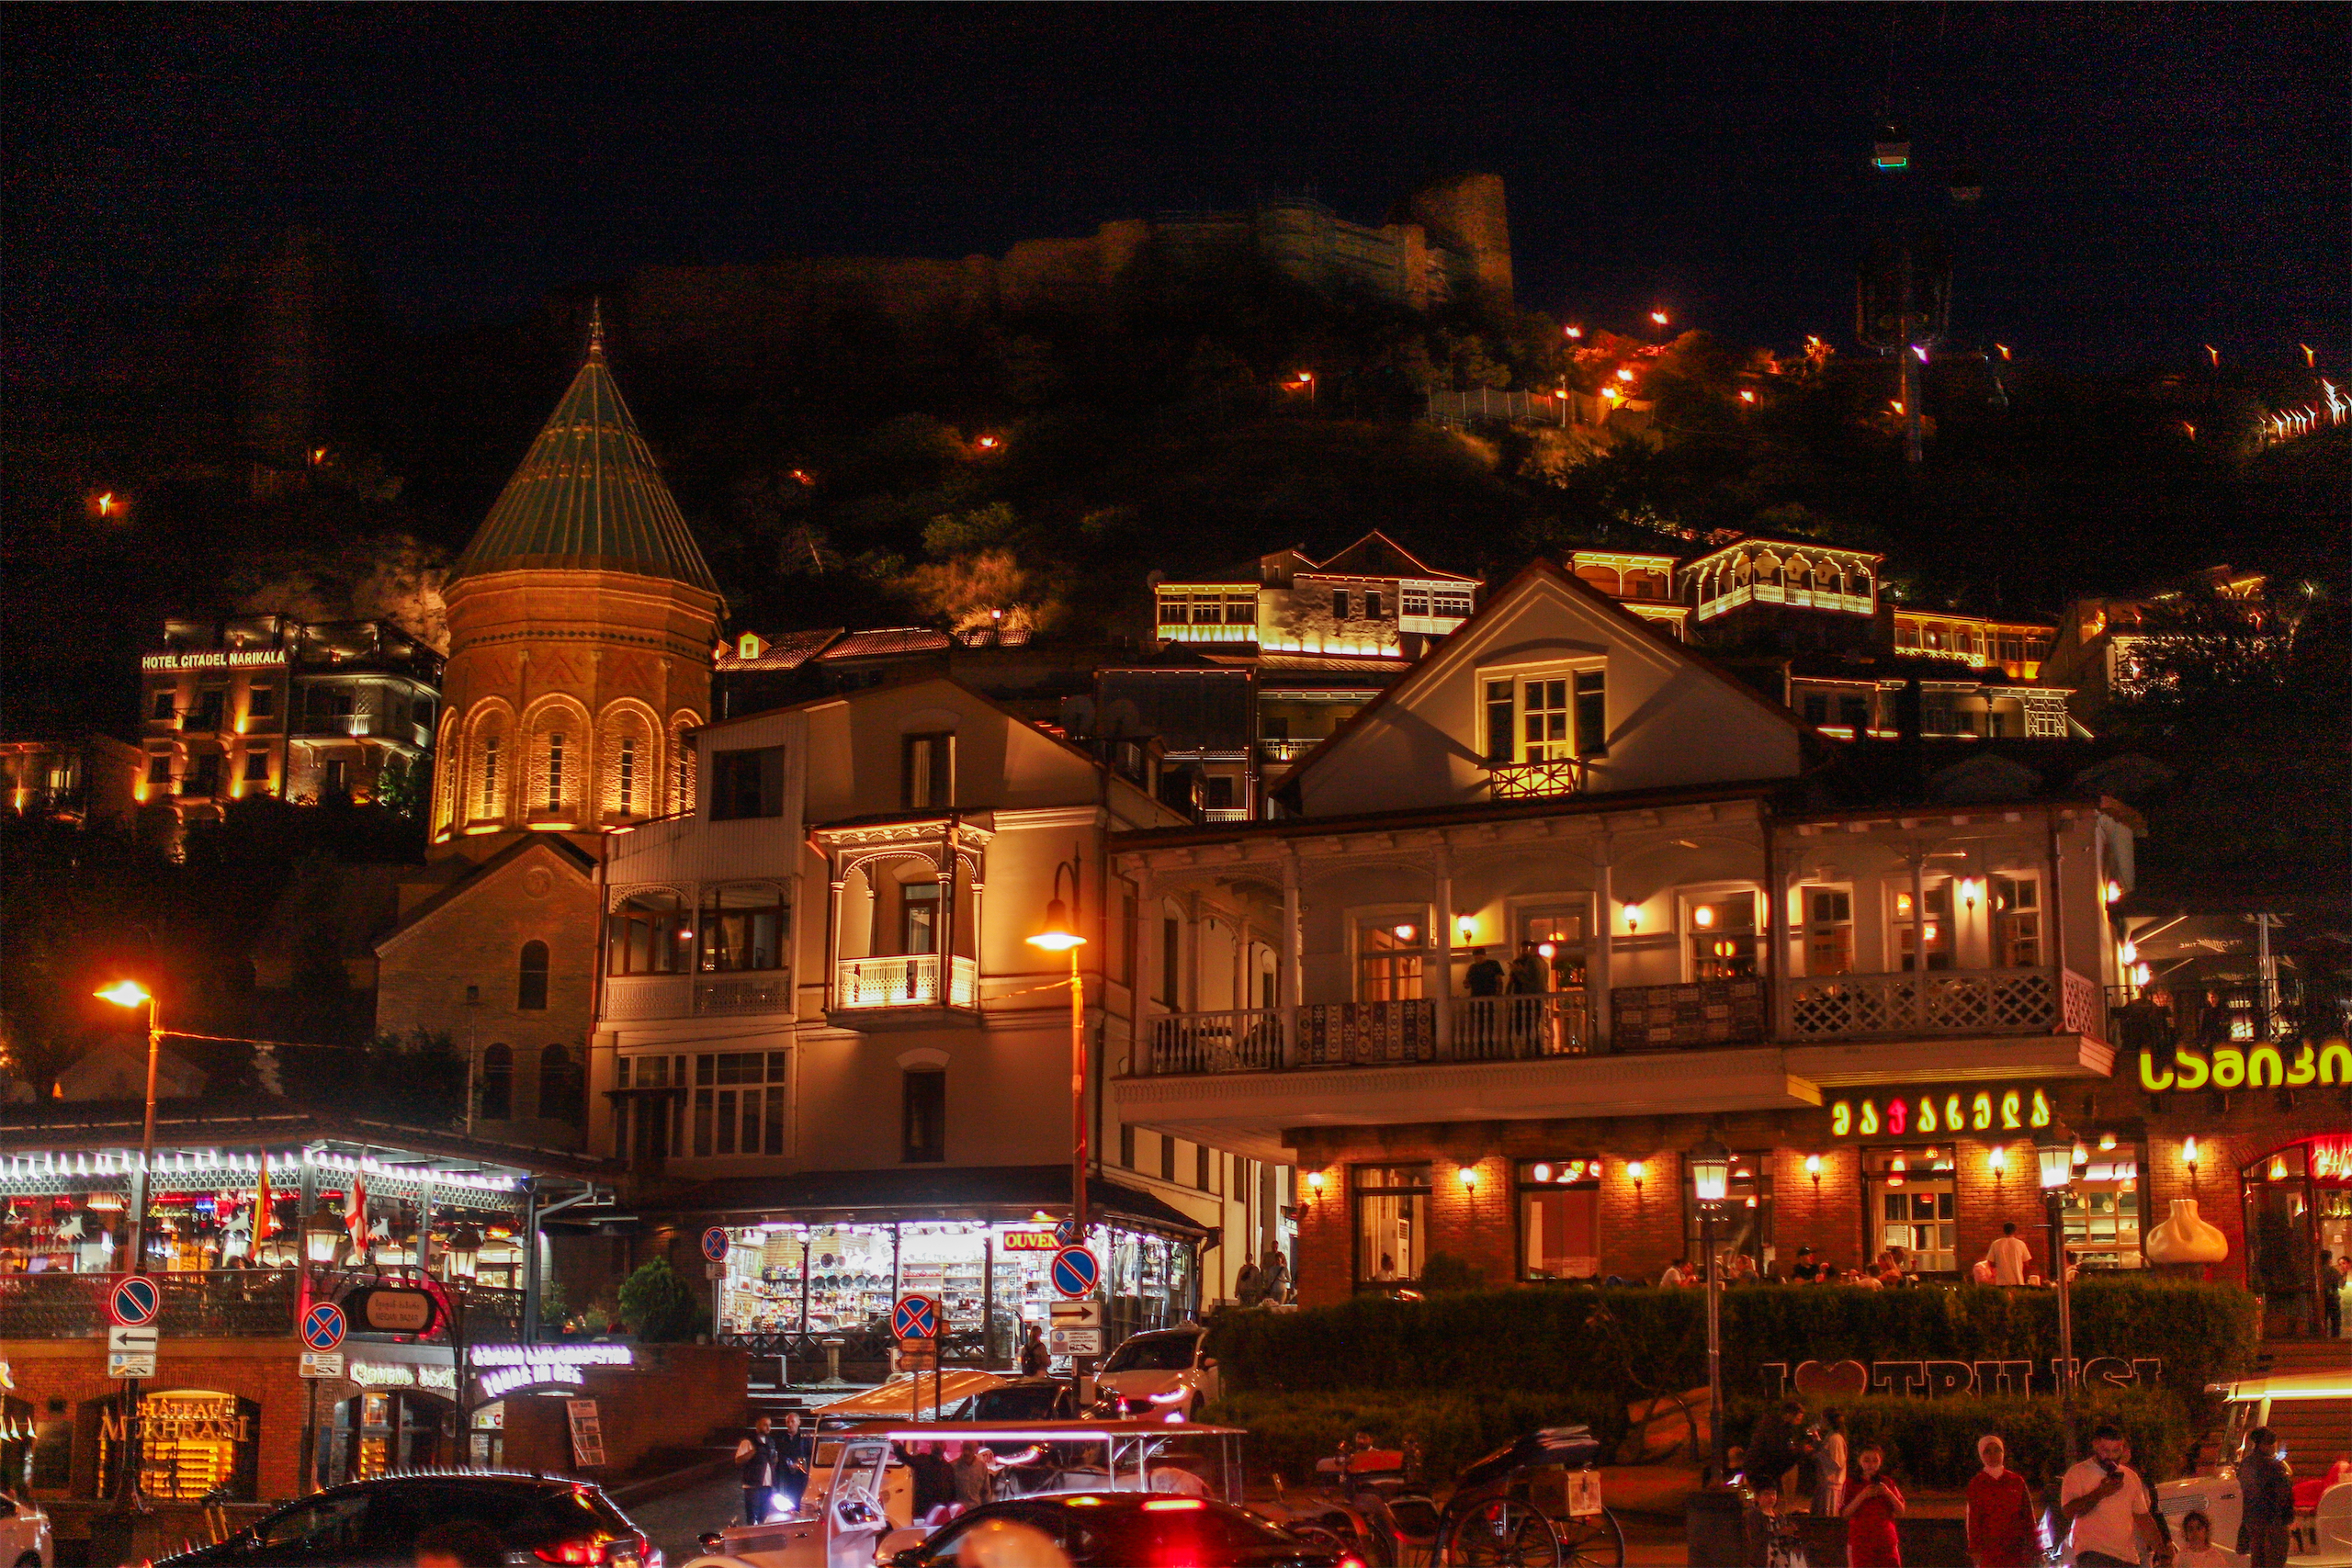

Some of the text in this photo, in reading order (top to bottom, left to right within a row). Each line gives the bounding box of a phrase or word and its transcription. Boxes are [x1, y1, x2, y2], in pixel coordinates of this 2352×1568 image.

[142, 650, 286, 670] HOTEL CITADEL NARIKALA
[2314, 1148, 2352, 1173] 24/
